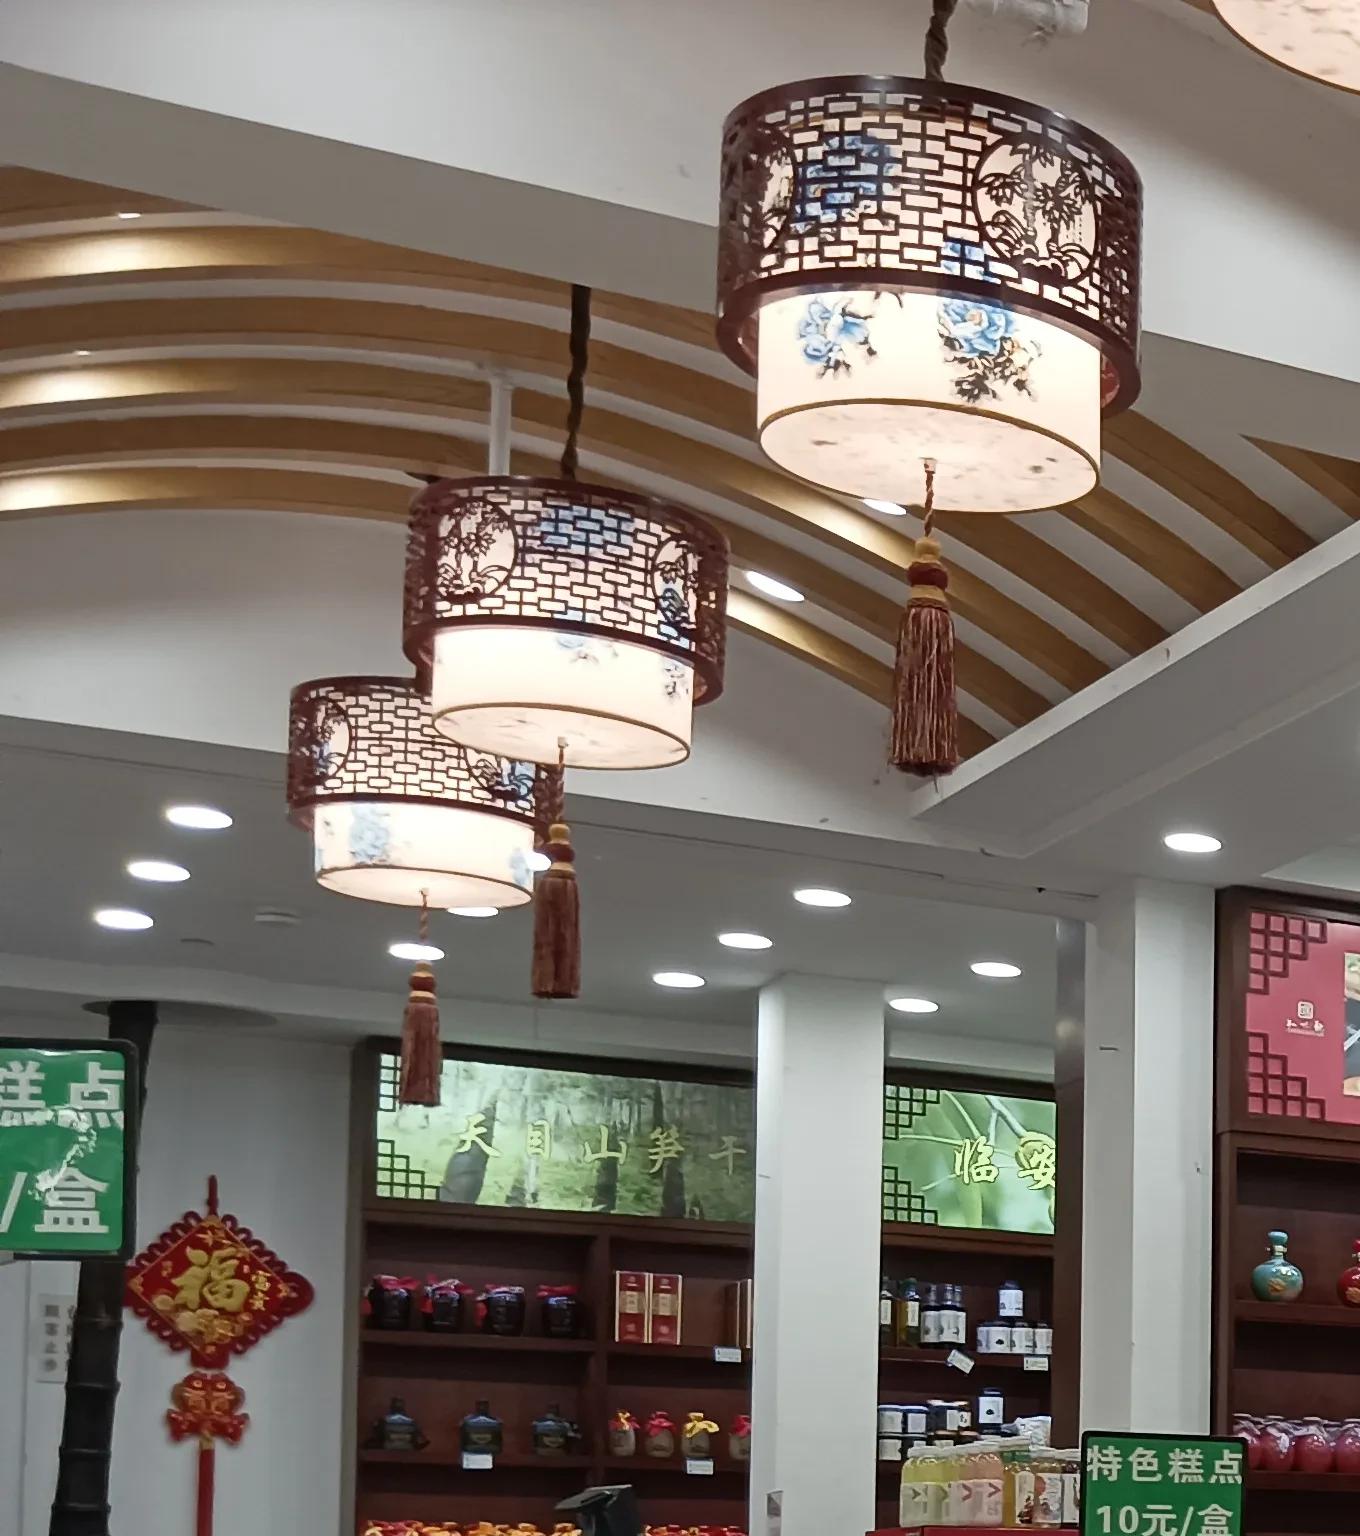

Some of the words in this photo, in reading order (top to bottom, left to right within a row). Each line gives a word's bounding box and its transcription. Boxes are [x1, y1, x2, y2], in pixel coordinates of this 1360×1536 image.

[453, 1113, 747, 1176] 天目山笋干
[953, 1131, 1055, 1191] 临安
[173, 1245, 250, 1312] 福
[1086, 1444, 1243, 1485] 特色糕点
